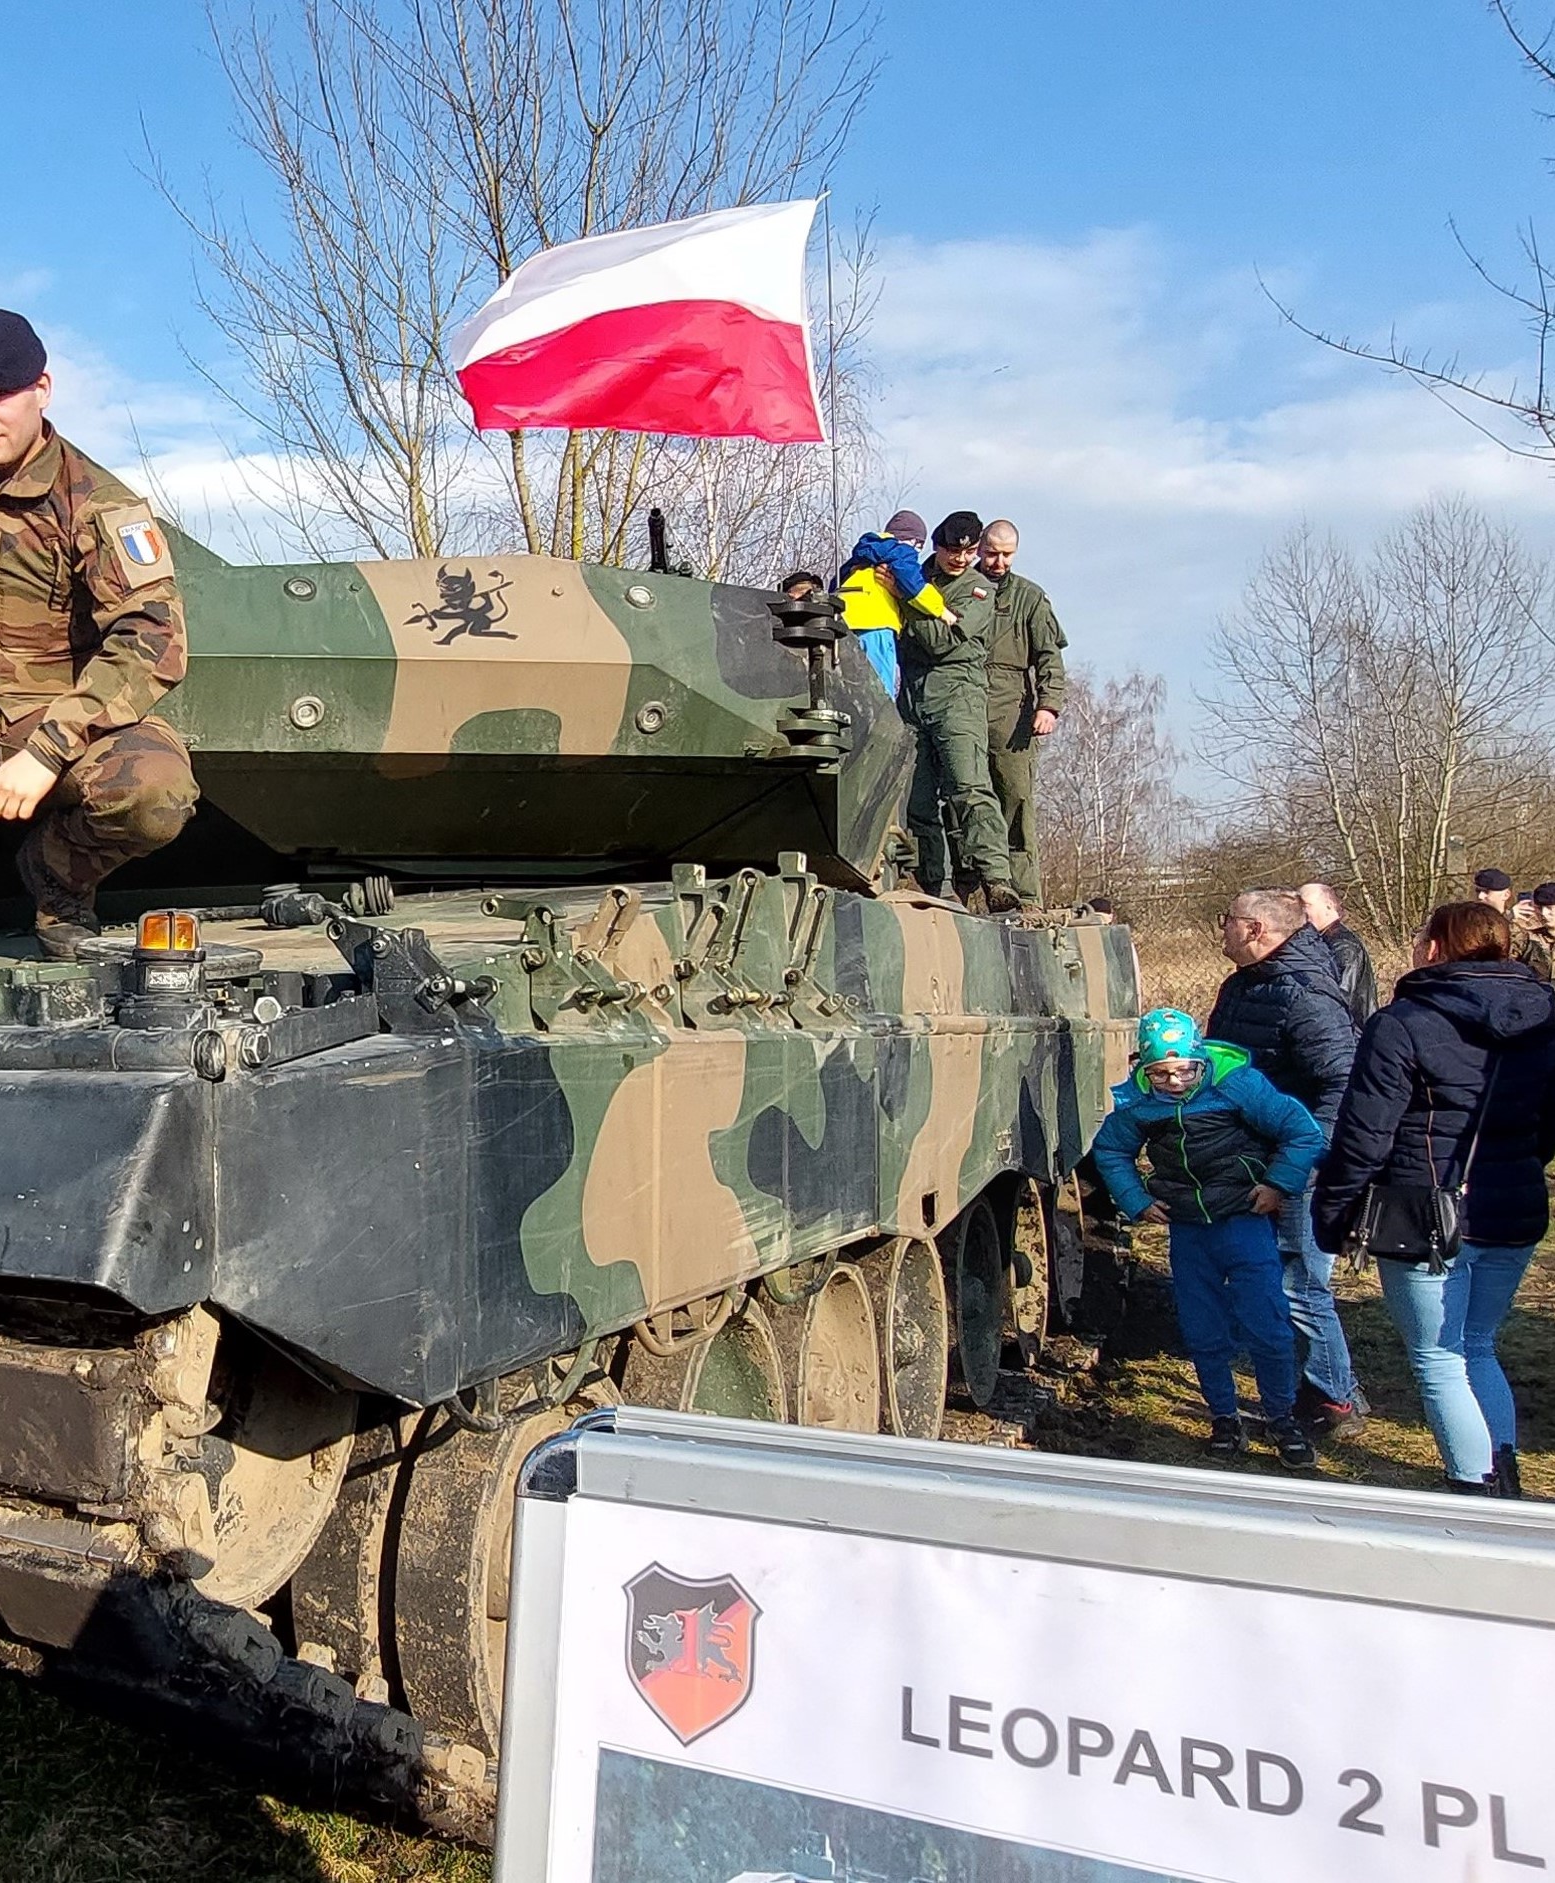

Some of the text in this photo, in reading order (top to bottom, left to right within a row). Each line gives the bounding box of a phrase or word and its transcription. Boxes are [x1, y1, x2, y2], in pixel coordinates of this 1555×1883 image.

[901, 1685, 1547, 1870] LEOPARD 2 PL
